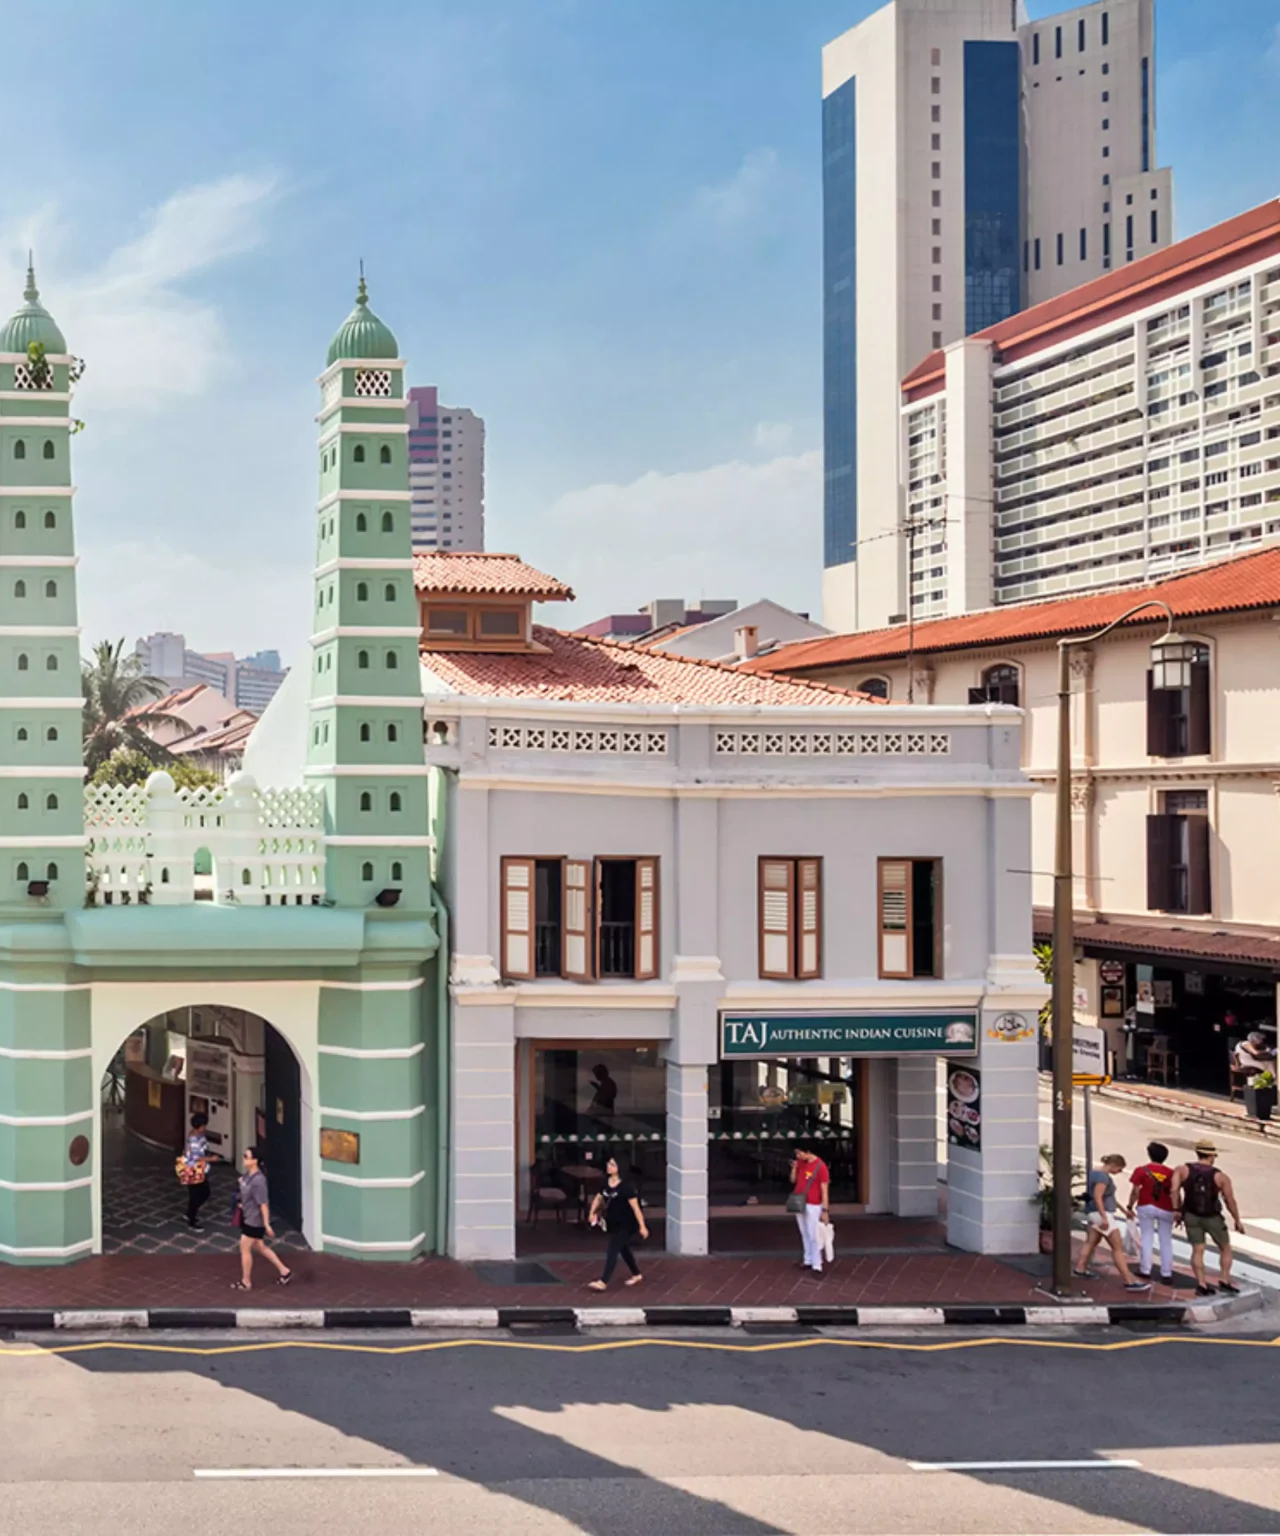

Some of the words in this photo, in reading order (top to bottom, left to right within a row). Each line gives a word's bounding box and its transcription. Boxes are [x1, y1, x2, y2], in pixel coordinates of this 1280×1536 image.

[725, 1021, 769, 1049] TAJ
[769, 1028, 843, 1040] AUTHENTIC
[845, 1027, 892, 1039] INDIAN
[894, 1026, 943, 1039] CUISINE
